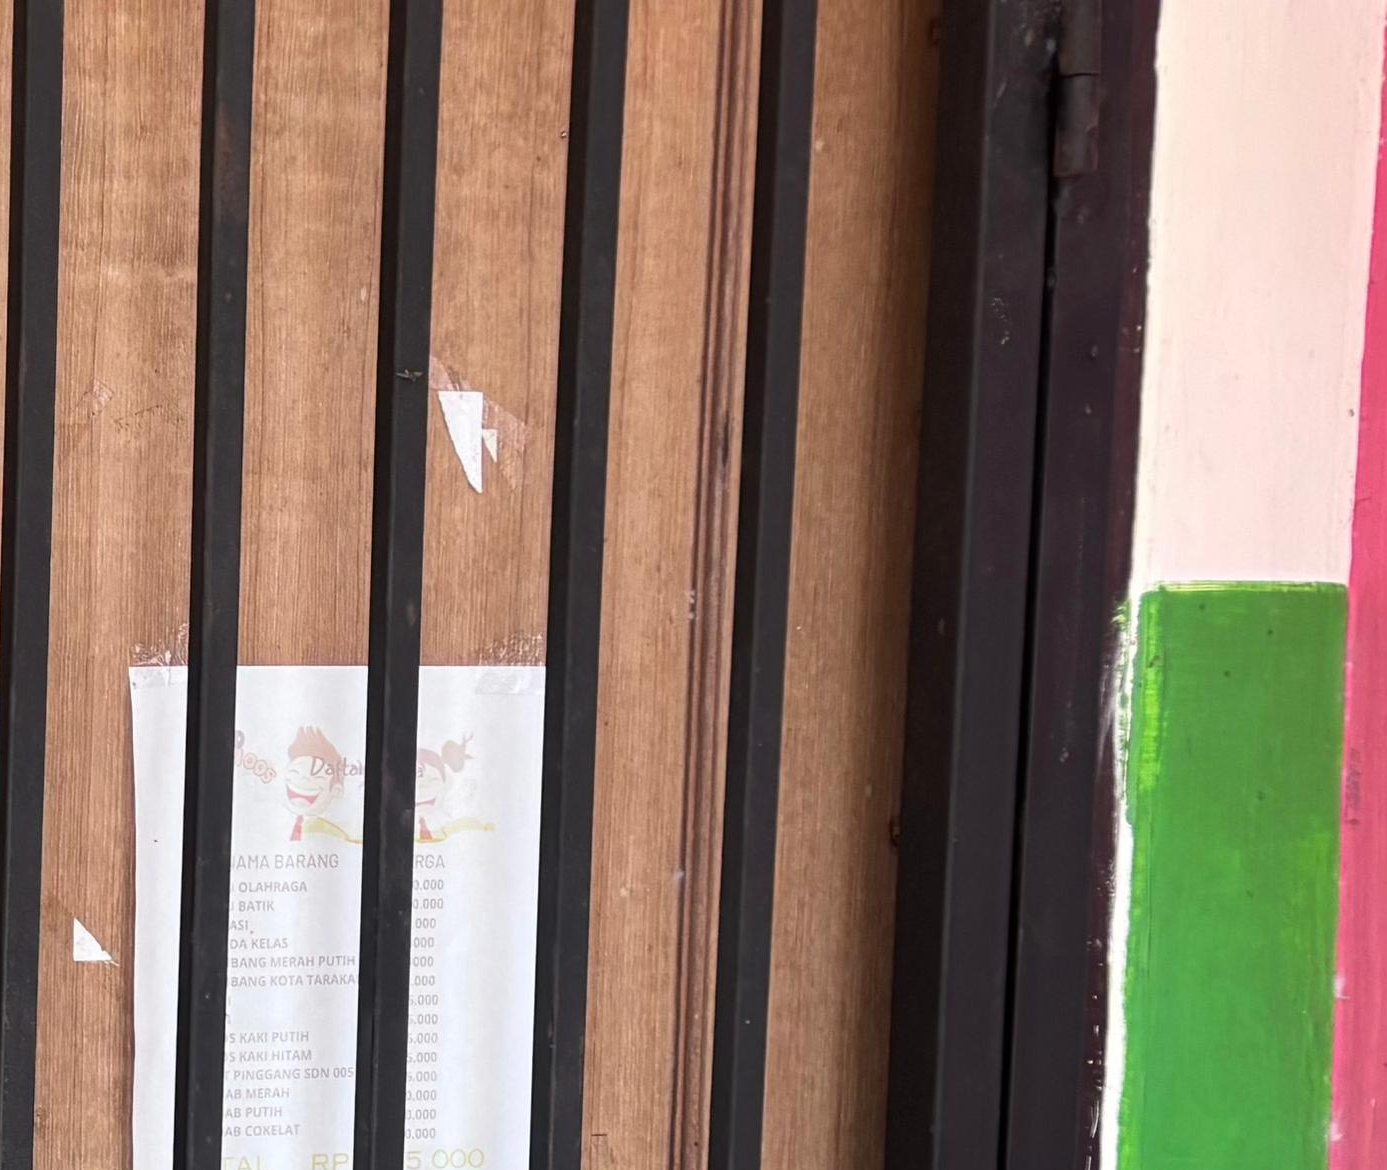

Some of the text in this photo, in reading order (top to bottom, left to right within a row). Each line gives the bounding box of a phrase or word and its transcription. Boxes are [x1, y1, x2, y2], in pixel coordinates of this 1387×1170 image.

[310, 757, 364, 777] Dafta
[275, 854, 340, 868] BARANG
[415, 855, 445, 868] RGA
[238, 880, 444, 893] OLAHRAGA 0.000
[238, 899, 444, 912] BATIK 0.000
[230, 918, 437, 931] ASI 000
[230, 937, 435, 950] DA KELAS 000
[231, 955, 434, 968] BANG MERAH PUTIH 000
[231, 976, 266, 987] BANG
[270, 975, 304, 987] KOTA
[306, 975, 359, 986] TARAKA
[239, 1032, 268, 1044] KAKI
[272, 1031, 309, 1042] PUTIH
[239, 1051, 268, 1062] KAKI
[271, 1050, 312, 1061] HITAM
[234, 1067, 437, 1081] PINGGANG SDN 005 5.000
[226, 1088, 437, 1100] AB MERAH 0.000
[226, 1107, 437, 1119] AB PUTIH 0.000
[225, 1125, 436, 1139] AB COKELAT 0.000
